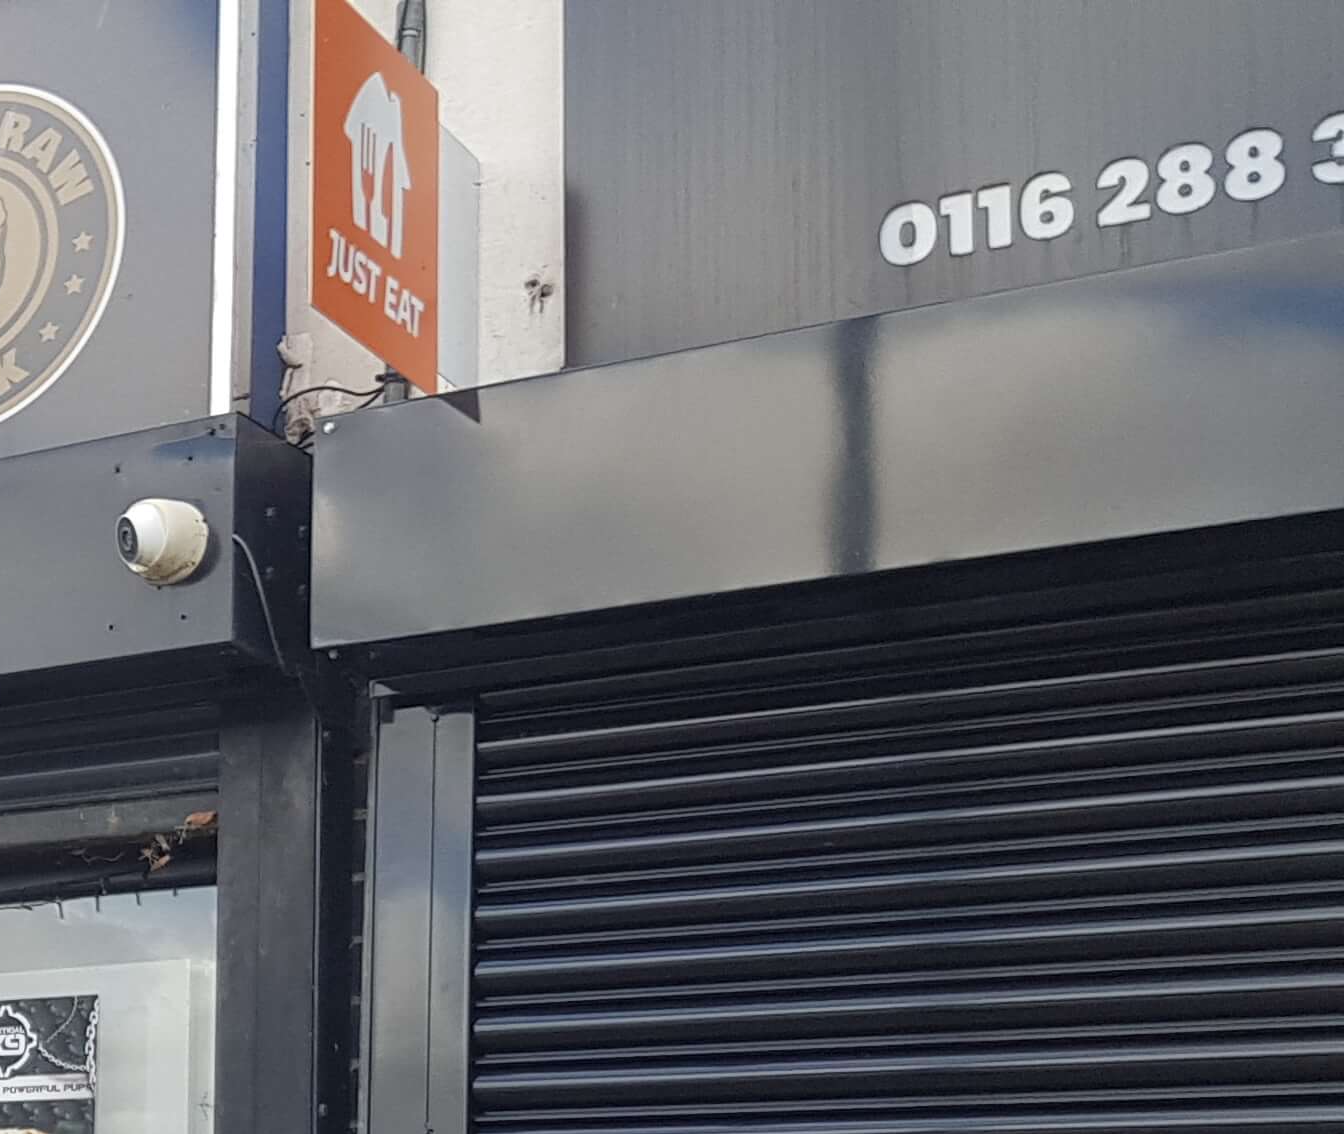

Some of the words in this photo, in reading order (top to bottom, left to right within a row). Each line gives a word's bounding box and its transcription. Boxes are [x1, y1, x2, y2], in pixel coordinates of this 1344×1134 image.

[878, 171, 1075, 267] 0116
[1096, 126, 1286, 228] 288
[327, 228, 381, 303] JUST
[383, 275, 425, 337] EAT
[3, 1084, 60, 1094] POWERFUL
